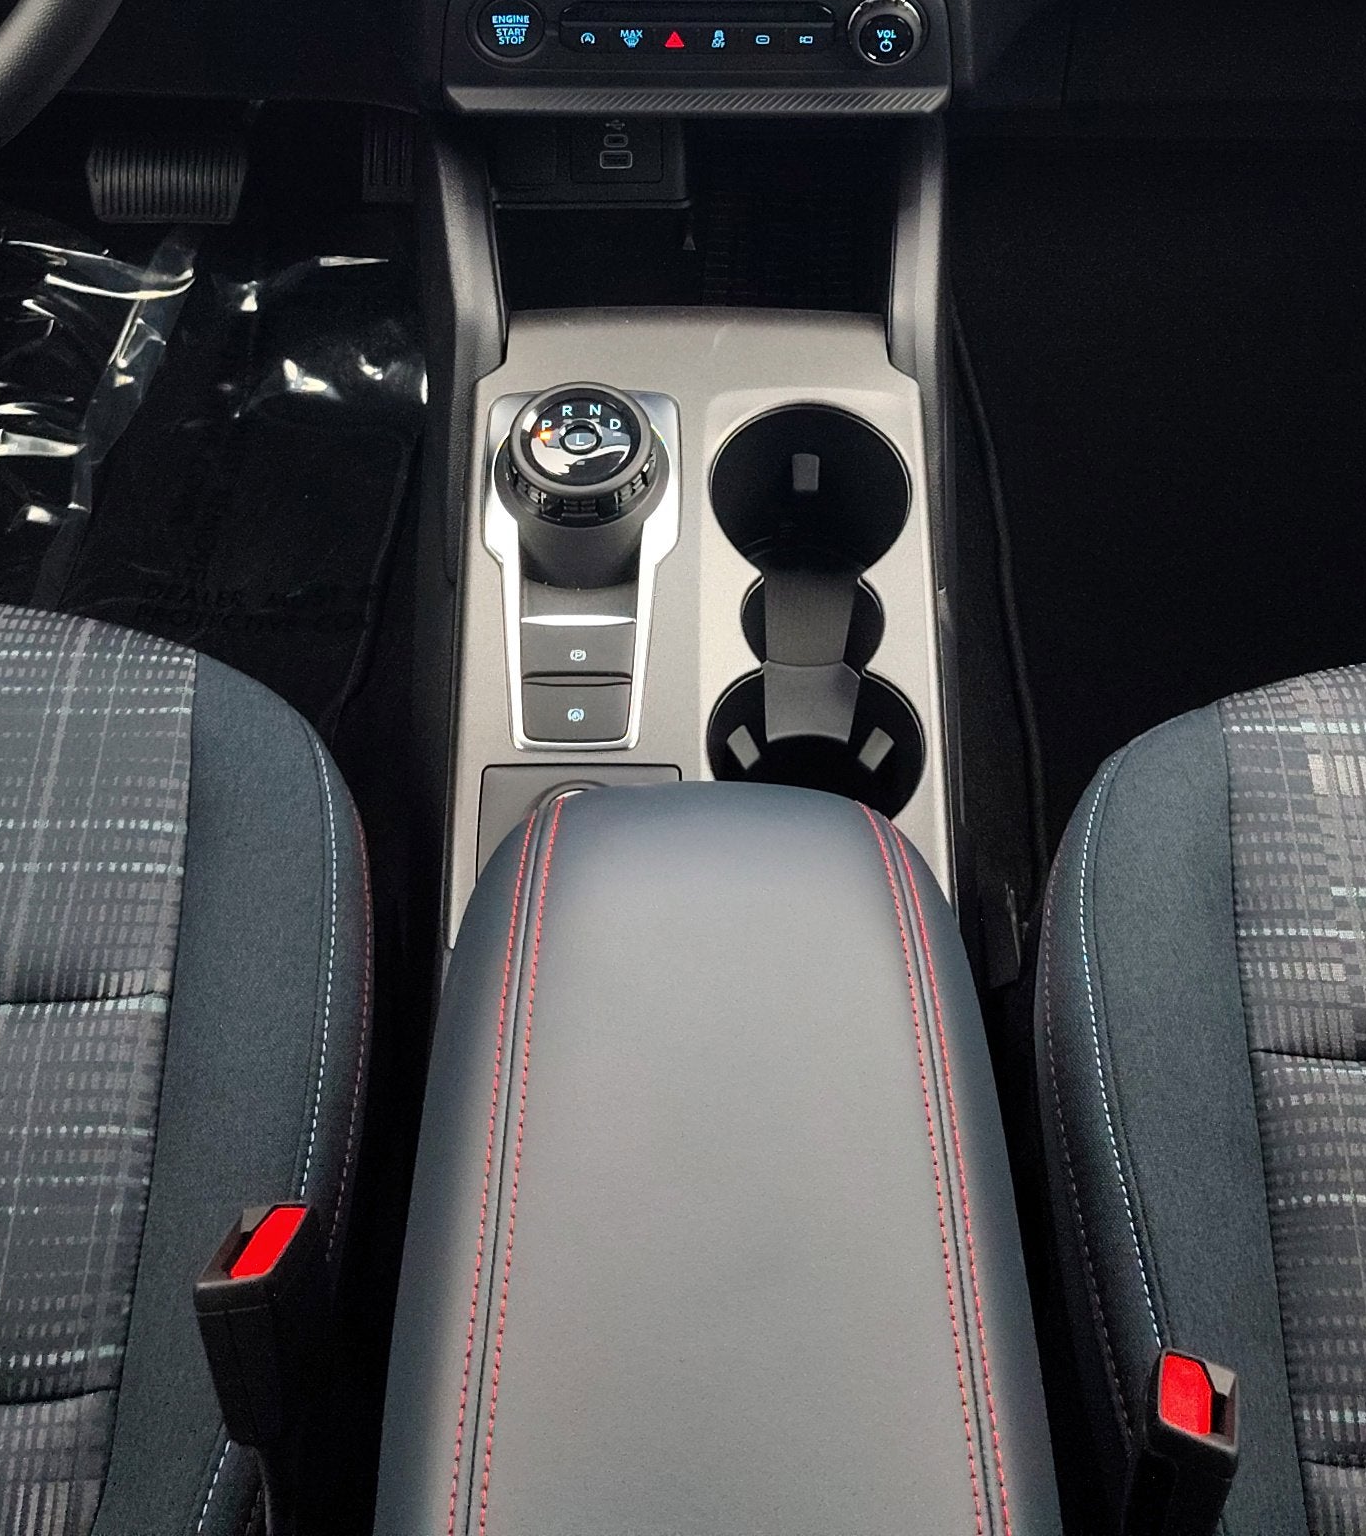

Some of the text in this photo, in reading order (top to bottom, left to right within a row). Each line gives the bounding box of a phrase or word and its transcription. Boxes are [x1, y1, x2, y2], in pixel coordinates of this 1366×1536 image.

[492, 15, 530, 24] ENGINE
[496, 28, 527, 36] START
[620, 29, 643, 38] MAX
[877, 30, 897, 39] VOL
[498, 36, 525, 45] STOP
[562, 405, 573, 416] R
[589, 404, 602, 416] N
[541, 420, 552, 430] P
[609, 419, 621, 430] D
[575, 434, 585, 445] L
